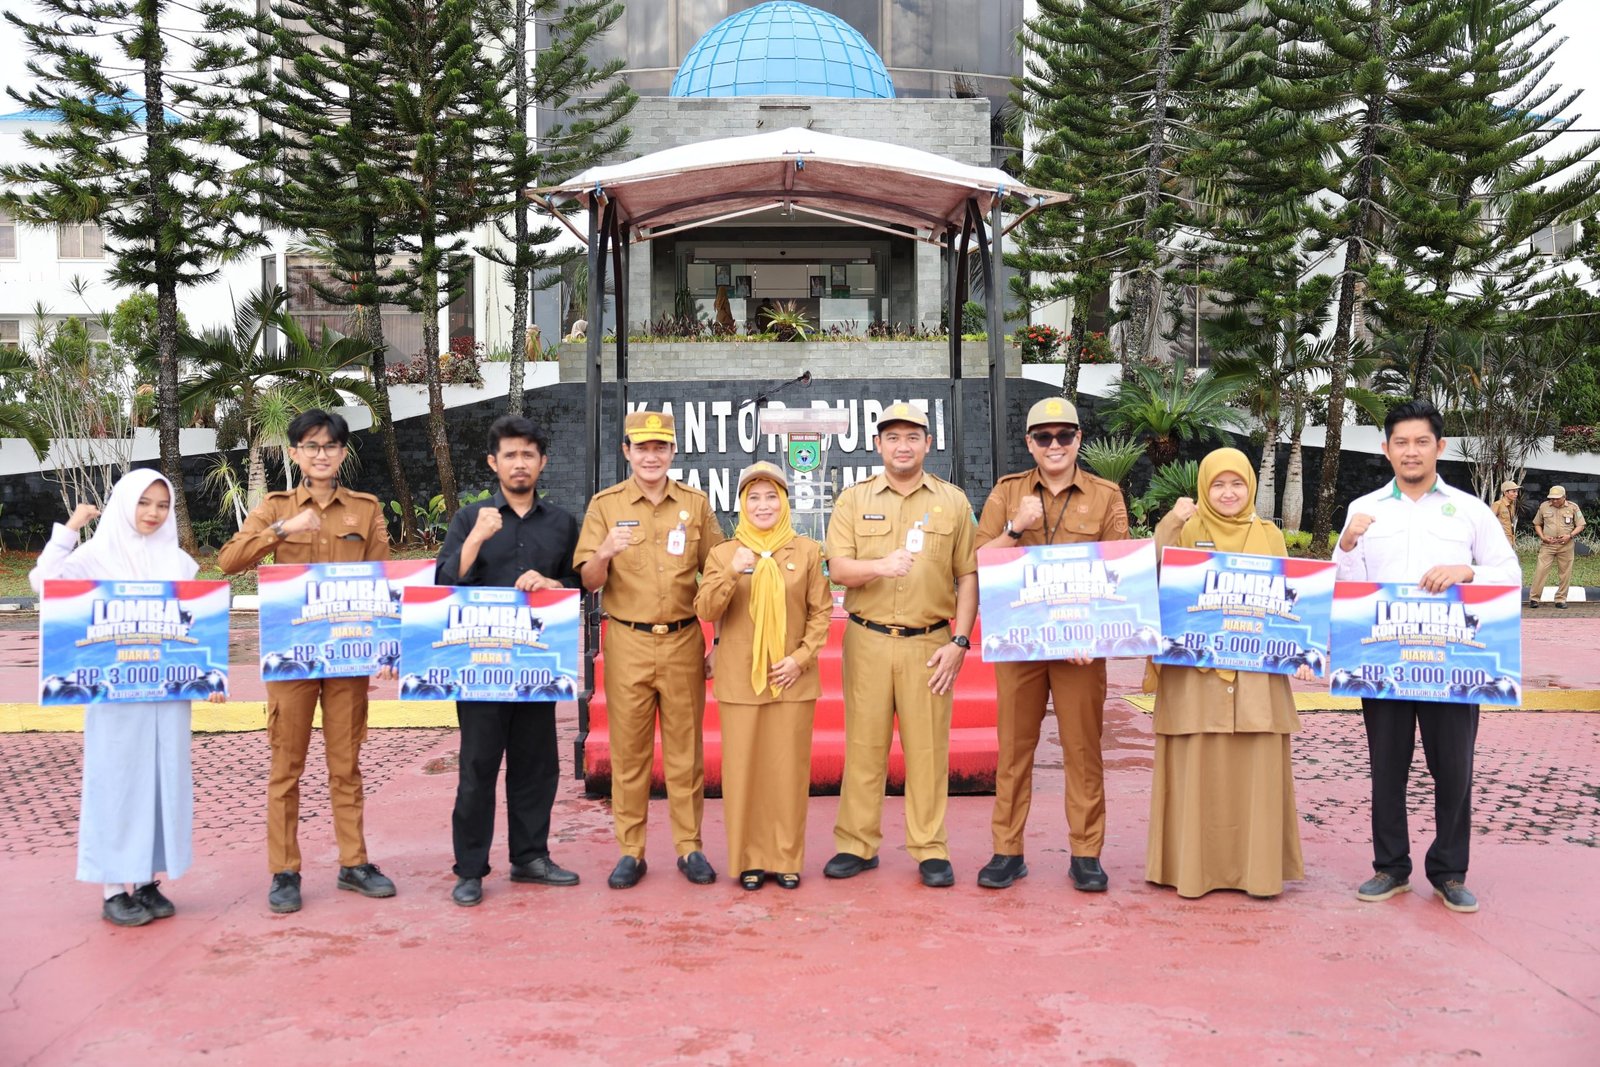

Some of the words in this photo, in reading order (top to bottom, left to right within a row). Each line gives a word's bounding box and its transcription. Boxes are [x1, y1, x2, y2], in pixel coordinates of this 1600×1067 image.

[1024, 560, 1109, 588] LOMBA
[306, 579, 390, 605] LOMBA
[1019, 583, 1067, 601] KONTEN
[1067, 582, 1118, 595] KREATIF
[1205, 570, 1286, 599] LOMBA
[93, 599, 181, 624] LOMBA
[302, 600, 349, 618] KONTEN
[349, 600, 400, 614] KREATIF
[1198, 594, 1244, 608] KONTEN
[1245, 594, 1294, 613] KREATIF
[448, 604, 532, 629] LOMBA
[1377, 600, 1467, 628] LOMBA
[86, 622, 137, 639] KONTEN
[138, 621, 190, 637] KREATIF
[442, 626, 489, 641] KONTEN
[490, 626, 540, 641] KREATIF
[1040, 622, 1132, 642] 10.000.000
[1223, 619, 1254, 632] JUARA
[1255, 622, 1263, 633] 2
[1371, 624, 1420, 638] KONTEN
[1422, 624, 1476, 642] KREATIF
[117, 650, 151, 662] JUARA
[153, 649, 161, 661] 3
[325, 641, 400, 659] 5.000.00
[1214, 635, 1297, 657] 5.000.000
[471, 652, 503, 664] JUARA
[1400, 650, 1436, 662] JUARA
[1437, 650, 1445, 662] 3
[110, 665, 197, 685] 3.000.000
[460, 668, 551, 685] 10.000.000
[1394, 666, 1486, 686] 3.000.000
